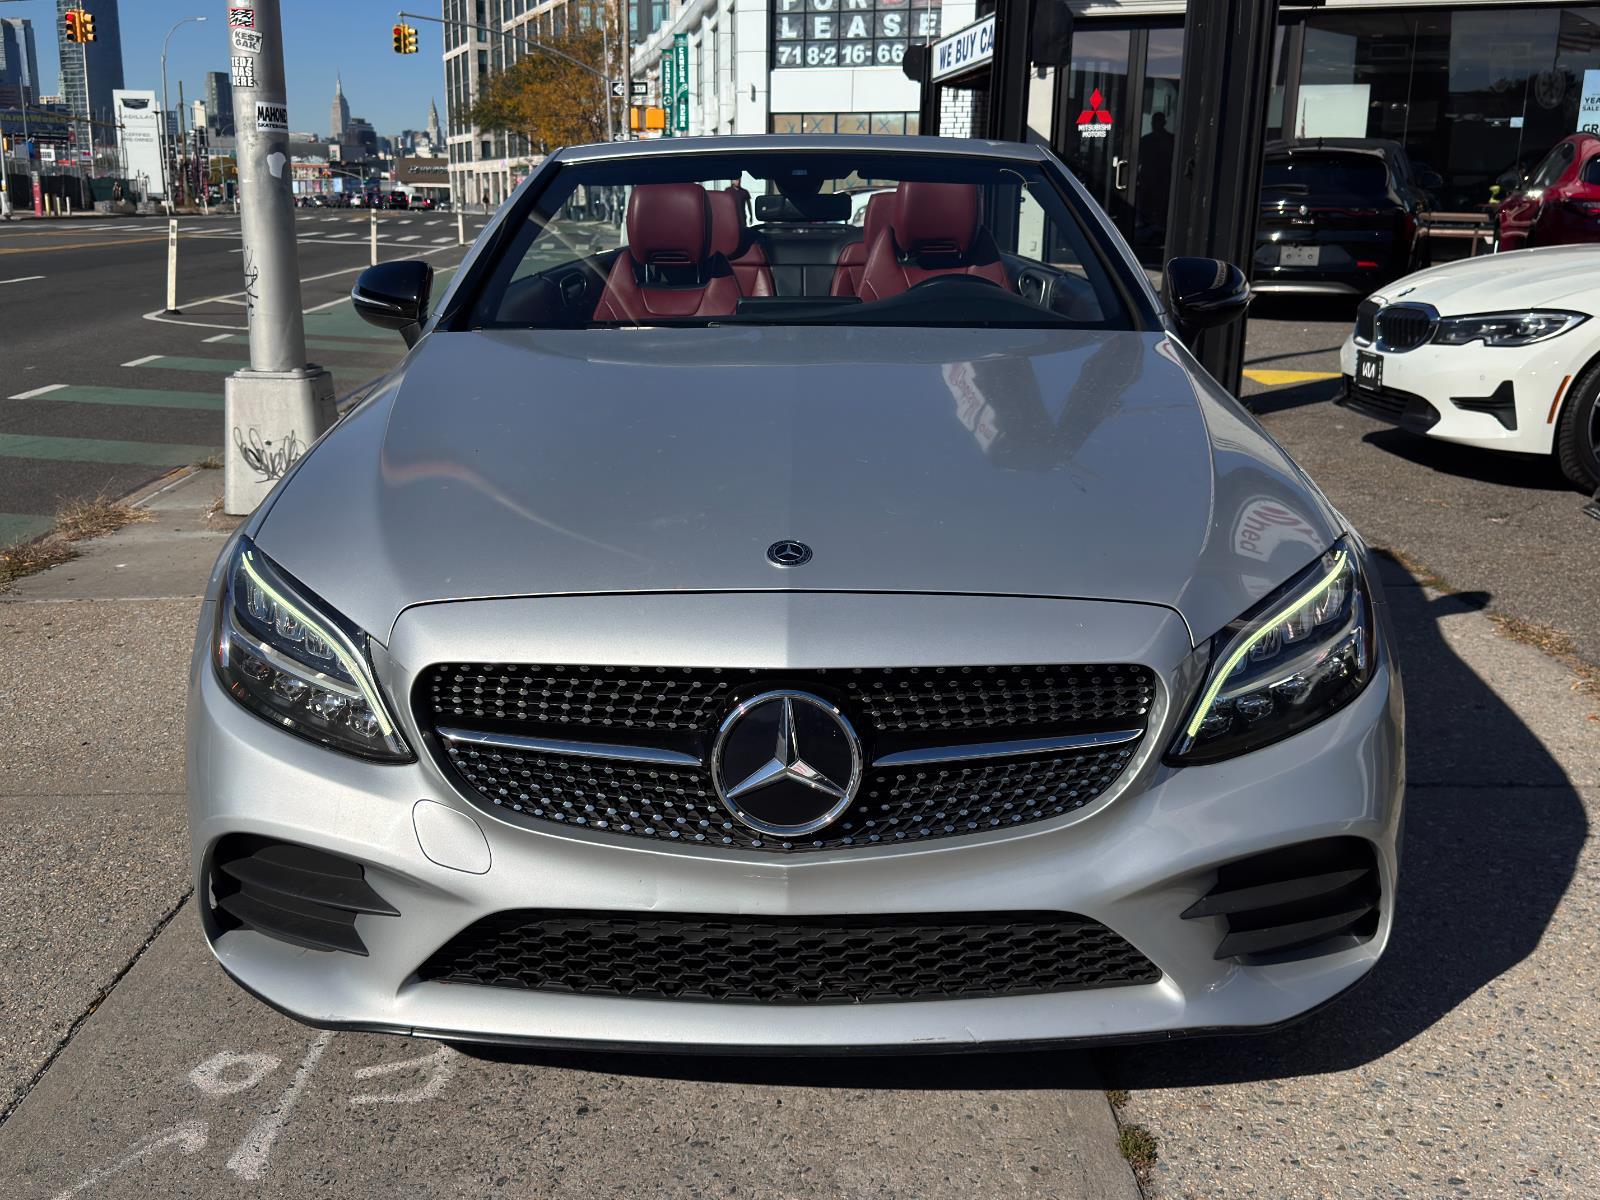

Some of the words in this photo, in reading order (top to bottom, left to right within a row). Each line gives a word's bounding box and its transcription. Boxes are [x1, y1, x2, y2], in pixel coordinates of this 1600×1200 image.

[781, 13, 937, 39] LEASE
[940, 43, 952, 70] WE
[955, 32, 977, 64] BUY
